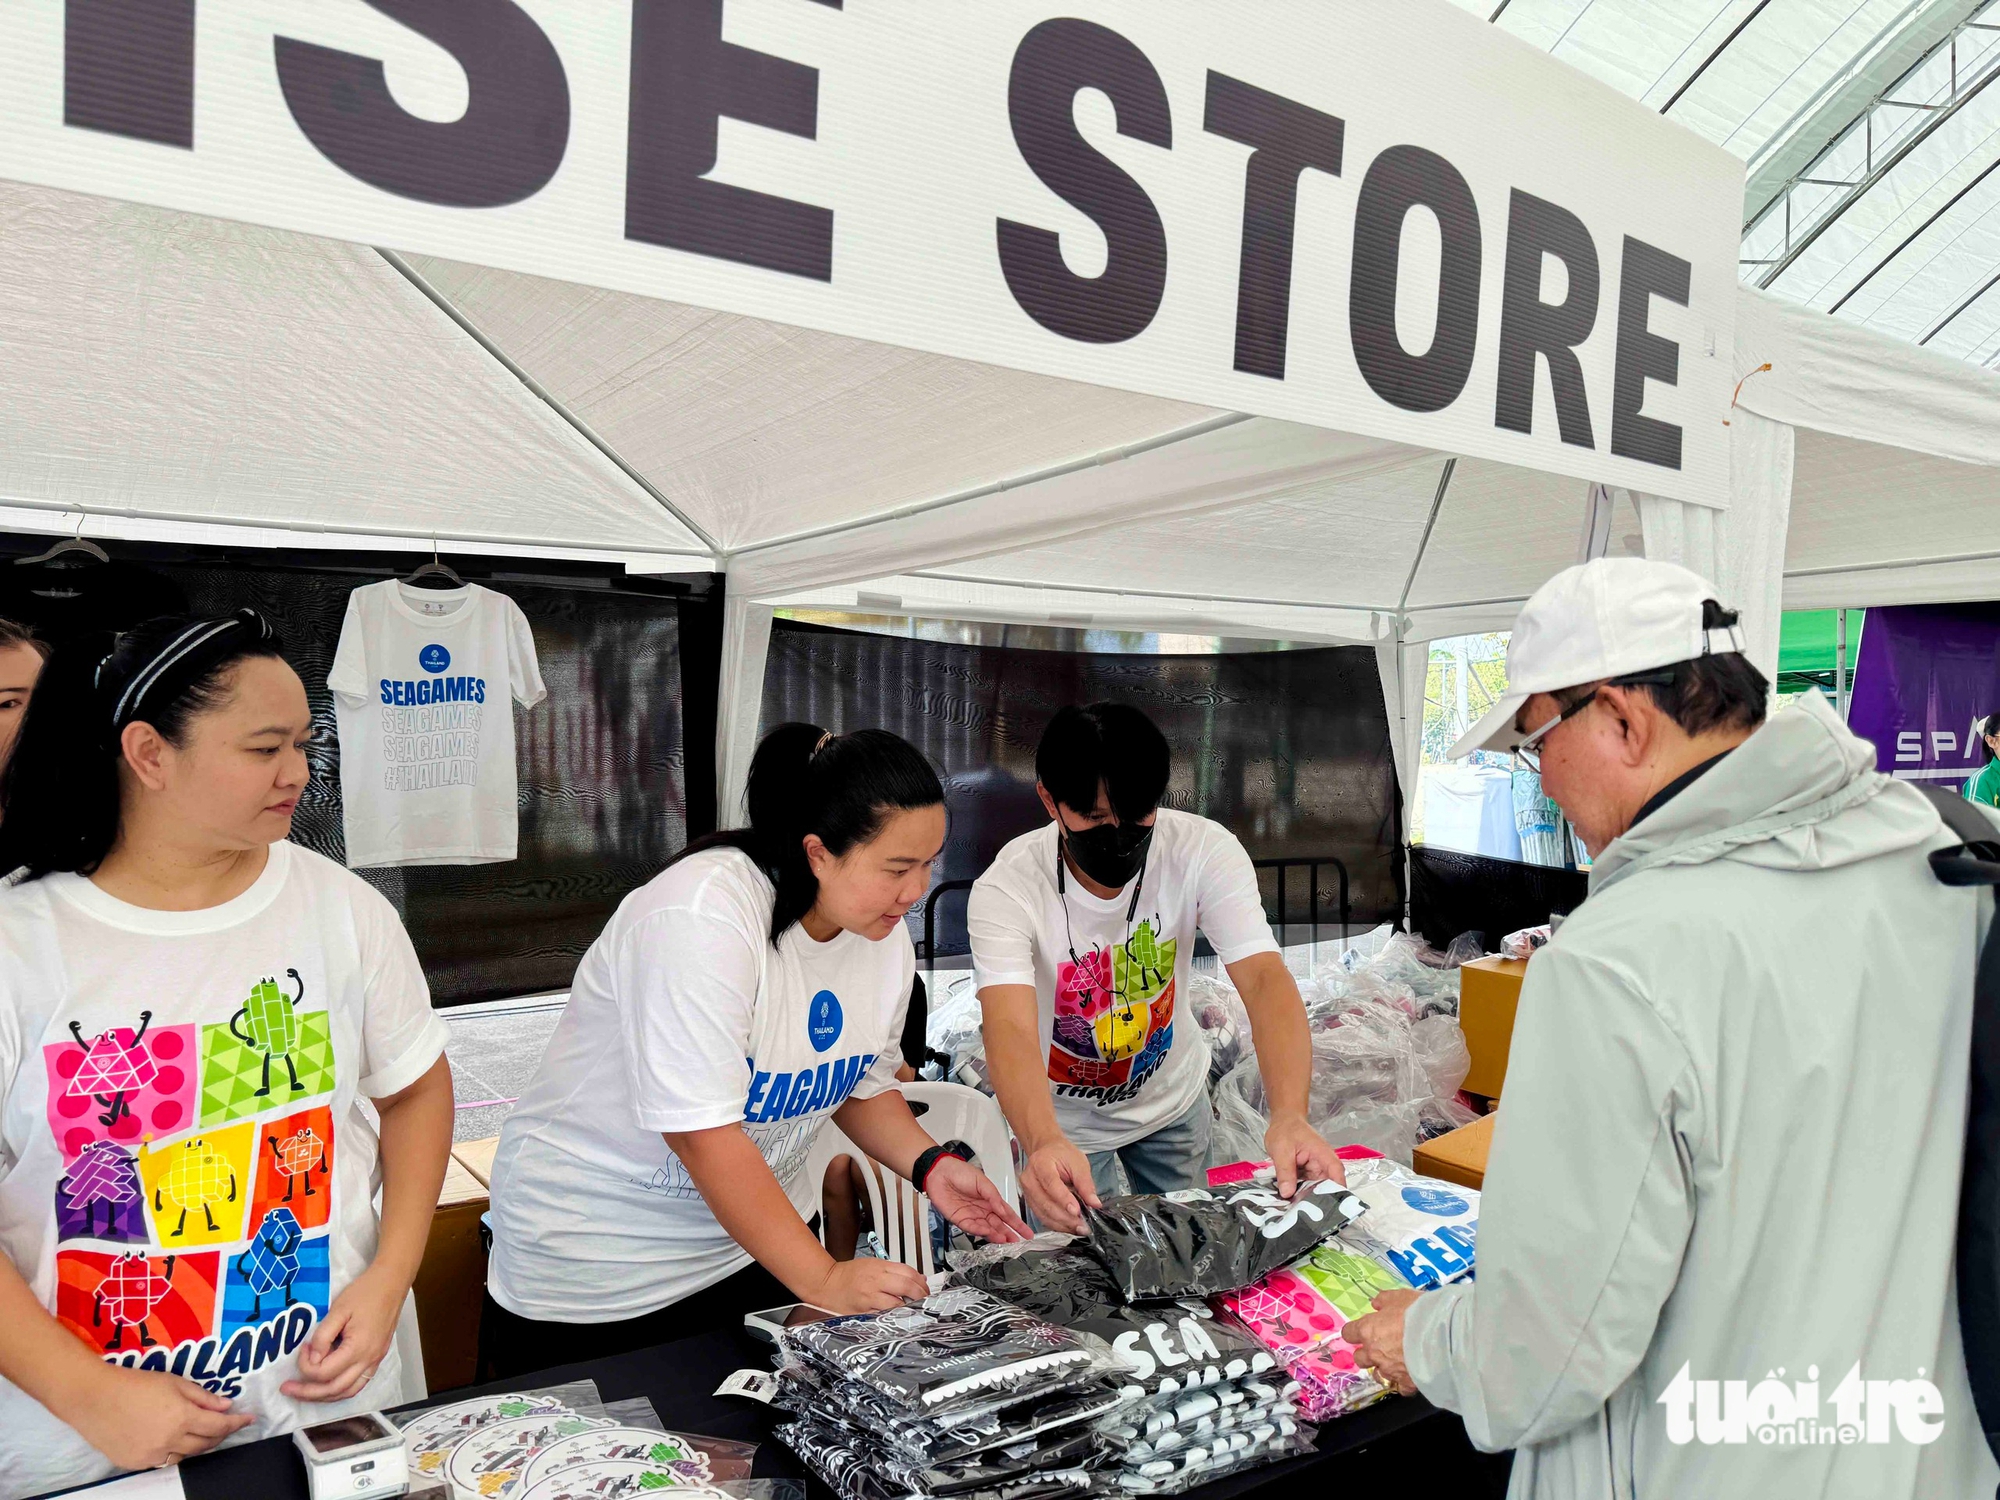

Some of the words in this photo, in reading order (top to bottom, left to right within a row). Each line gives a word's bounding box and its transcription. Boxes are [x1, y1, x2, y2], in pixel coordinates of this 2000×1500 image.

[996, 17, 1692, 471] STORE
[380, 676, 486, 706] SEAGAMES
[382, 704, 483, 735] SEAGAMES
[383, 731, 479, 763] SEAGAMES
[743, 1054, 880, 1124] EAGAME
[1056, 1050, 1168, 1100] THAILAND
[920, 1350, 995, 1375] THAILAND
[1112, 1316, 1221, 1381] SEA
